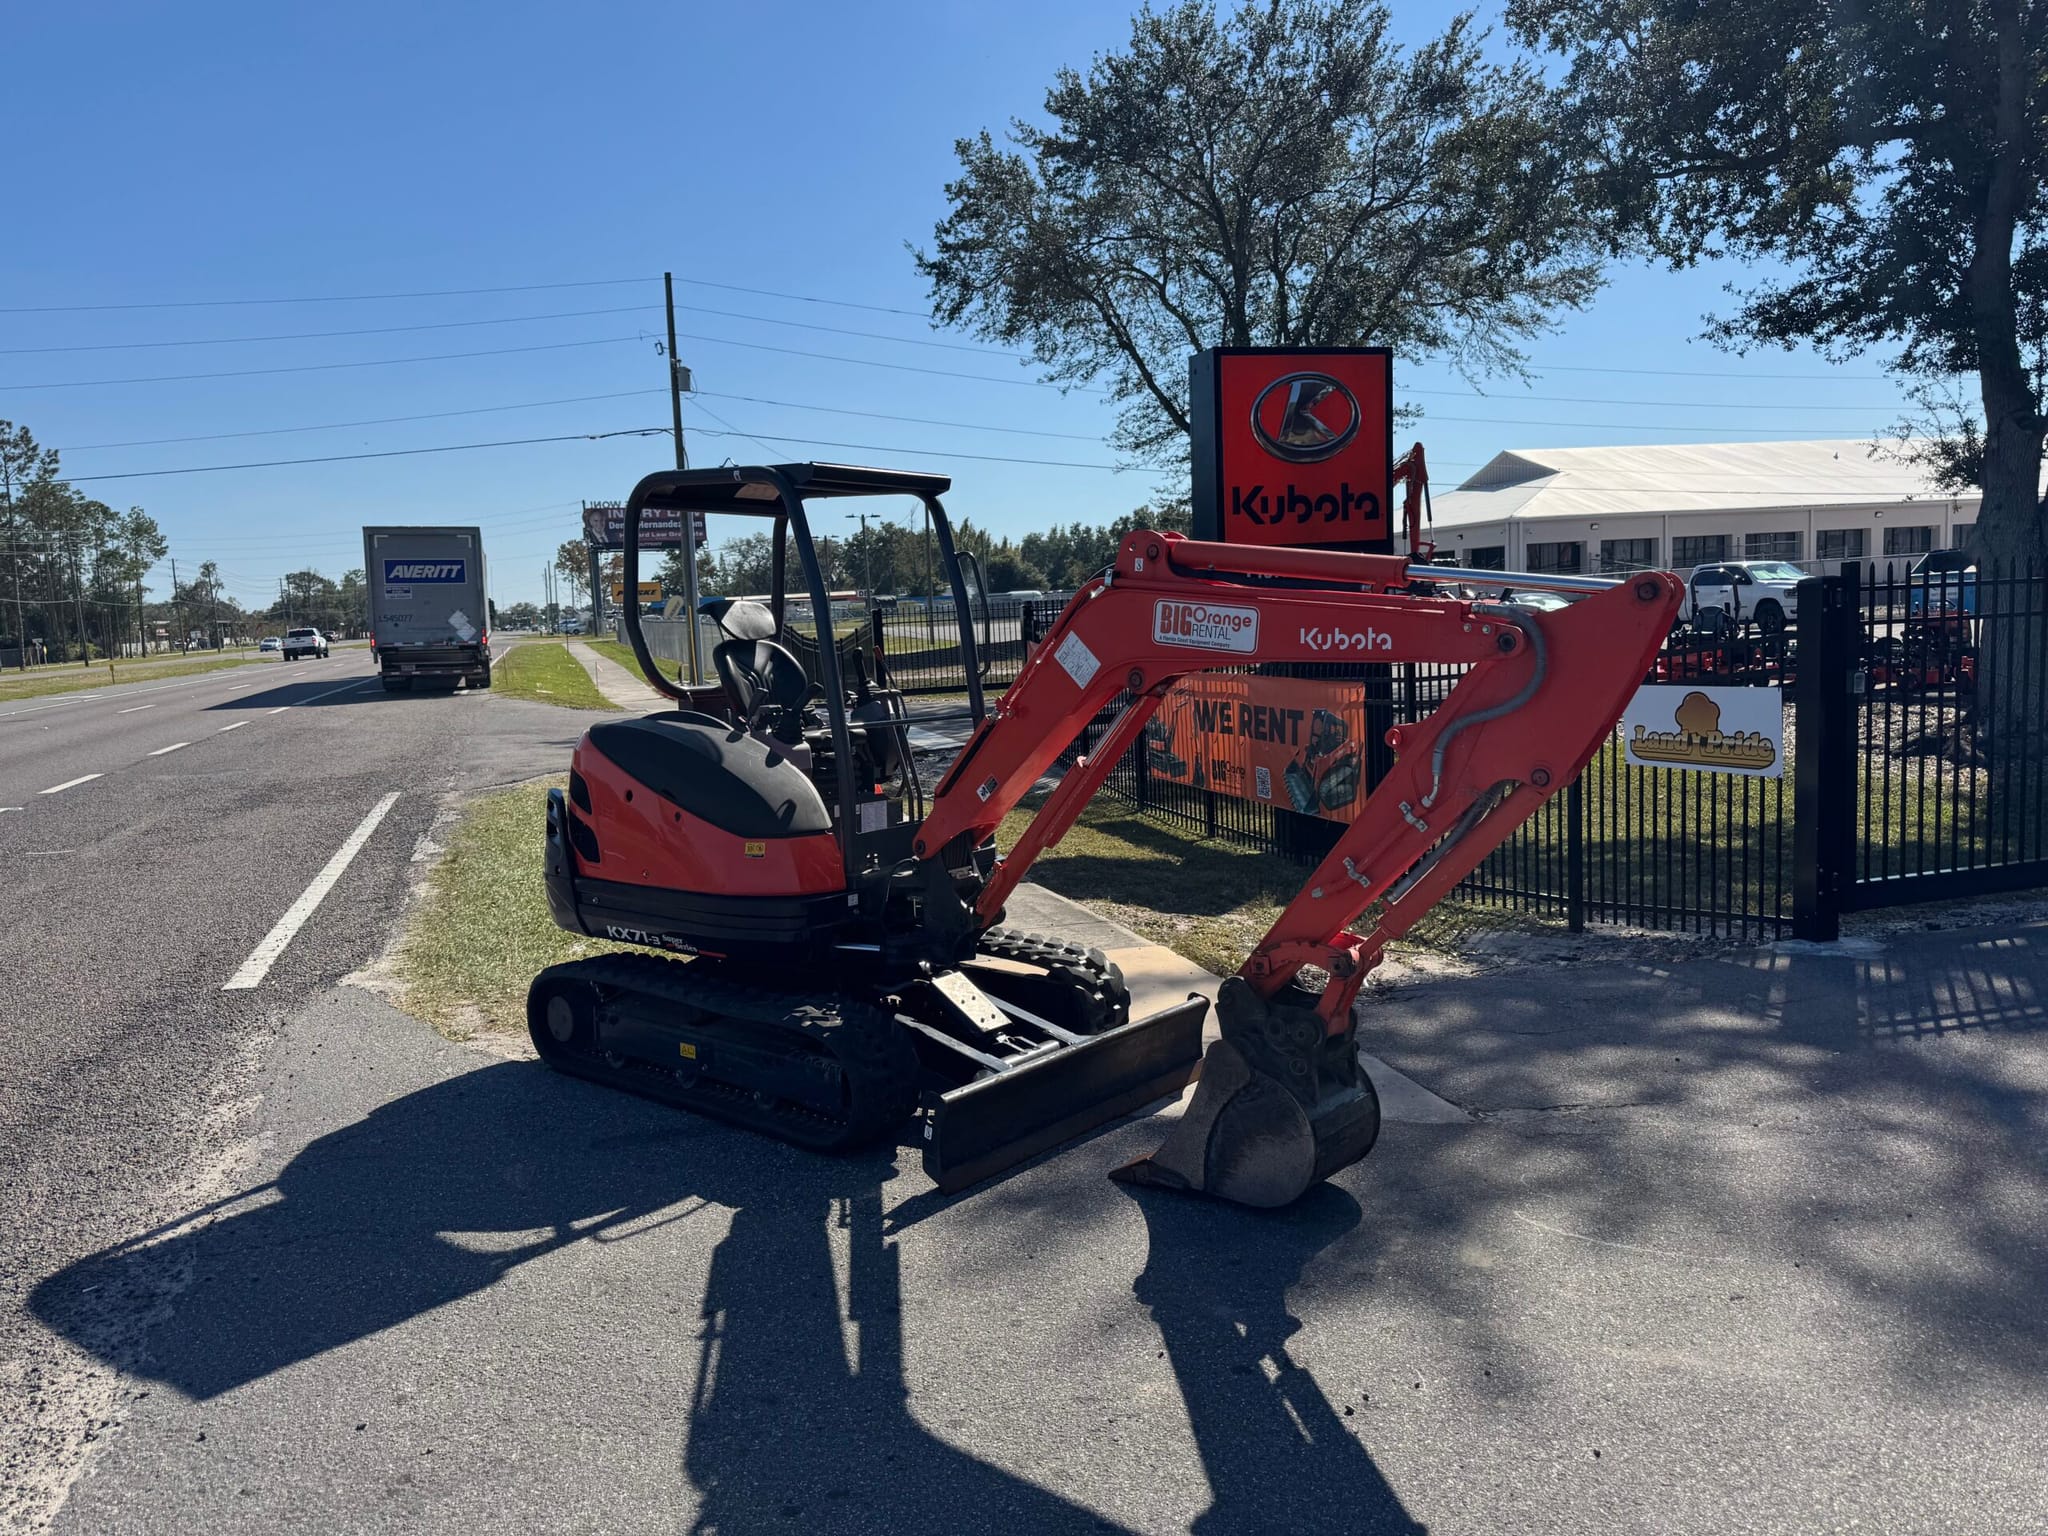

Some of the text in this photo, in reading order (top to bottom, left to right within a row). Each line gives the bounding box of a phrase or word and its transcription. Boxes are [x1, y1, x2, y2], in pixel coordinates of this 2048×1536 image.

[608, 508, 661, 518] INRY
[1232, 483, 1380, 525] Kubota
[389, 565, 461, 578] AVERITT
[1160, 604, 1252, 636] BIG Orange
[1192, 623, 1231, 640] RENTAL
[1300, 627, 1392, 650] Kubota
[1194, 700, 1304, 746] WE RENT
[1634, 725, 1773, 758] Land Pride
[606, 925, 661, 945] KX71-3
